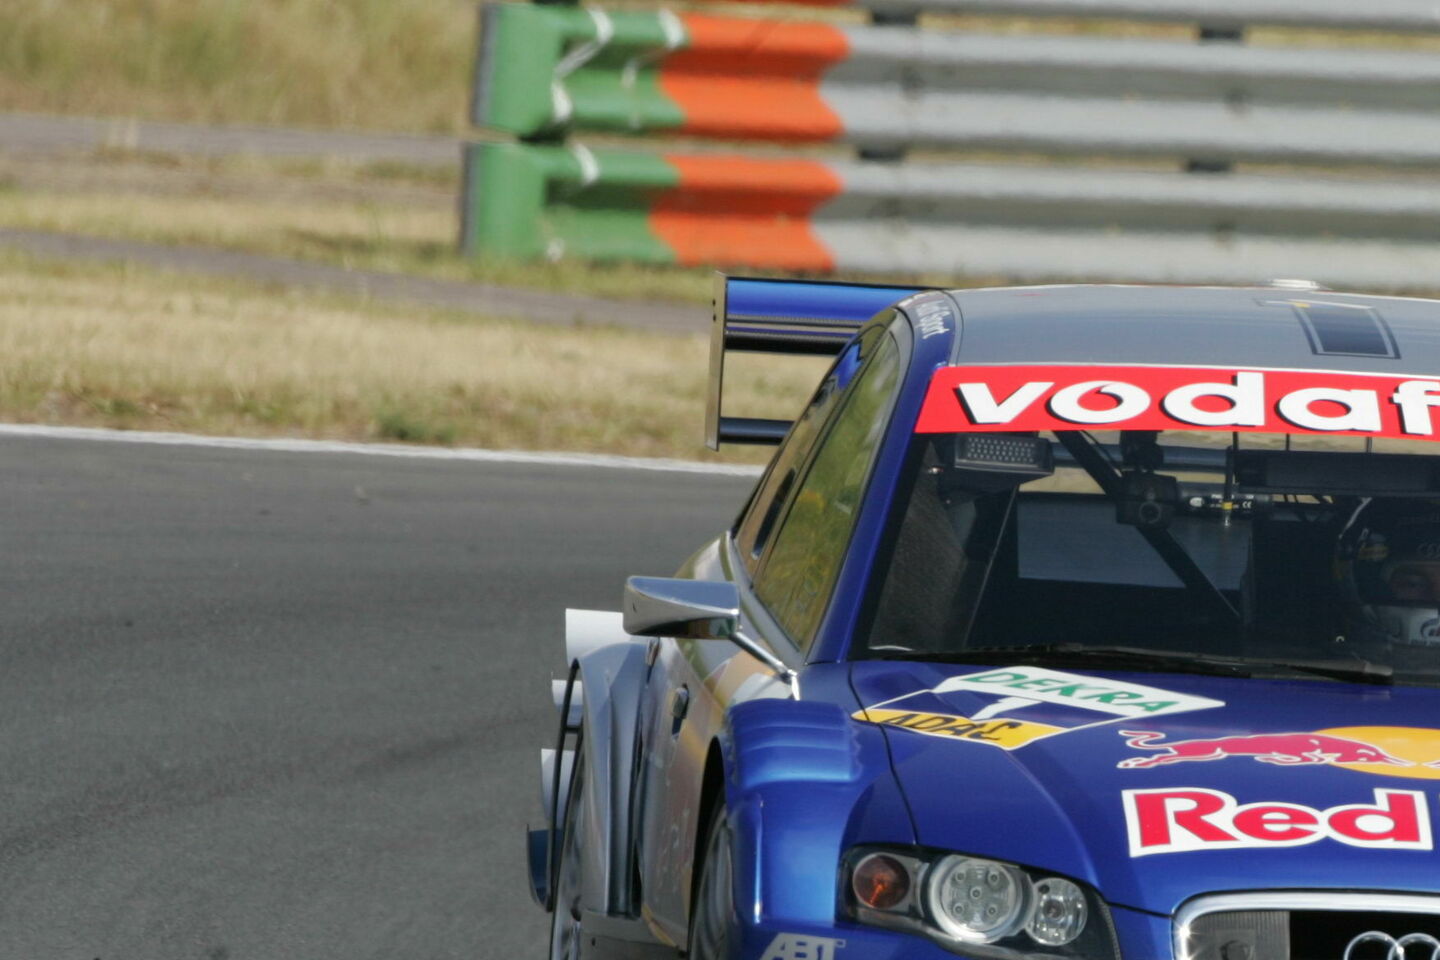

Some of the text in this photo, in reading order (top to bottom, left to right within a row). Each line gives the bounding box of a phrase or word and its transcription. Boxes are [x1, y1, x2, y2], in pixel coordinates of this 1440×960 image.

[961, 672, 1180, 712] DEKRA
[883, 713, 1022, 741] ADAC
[1131, 790, 1421, 848] Red
